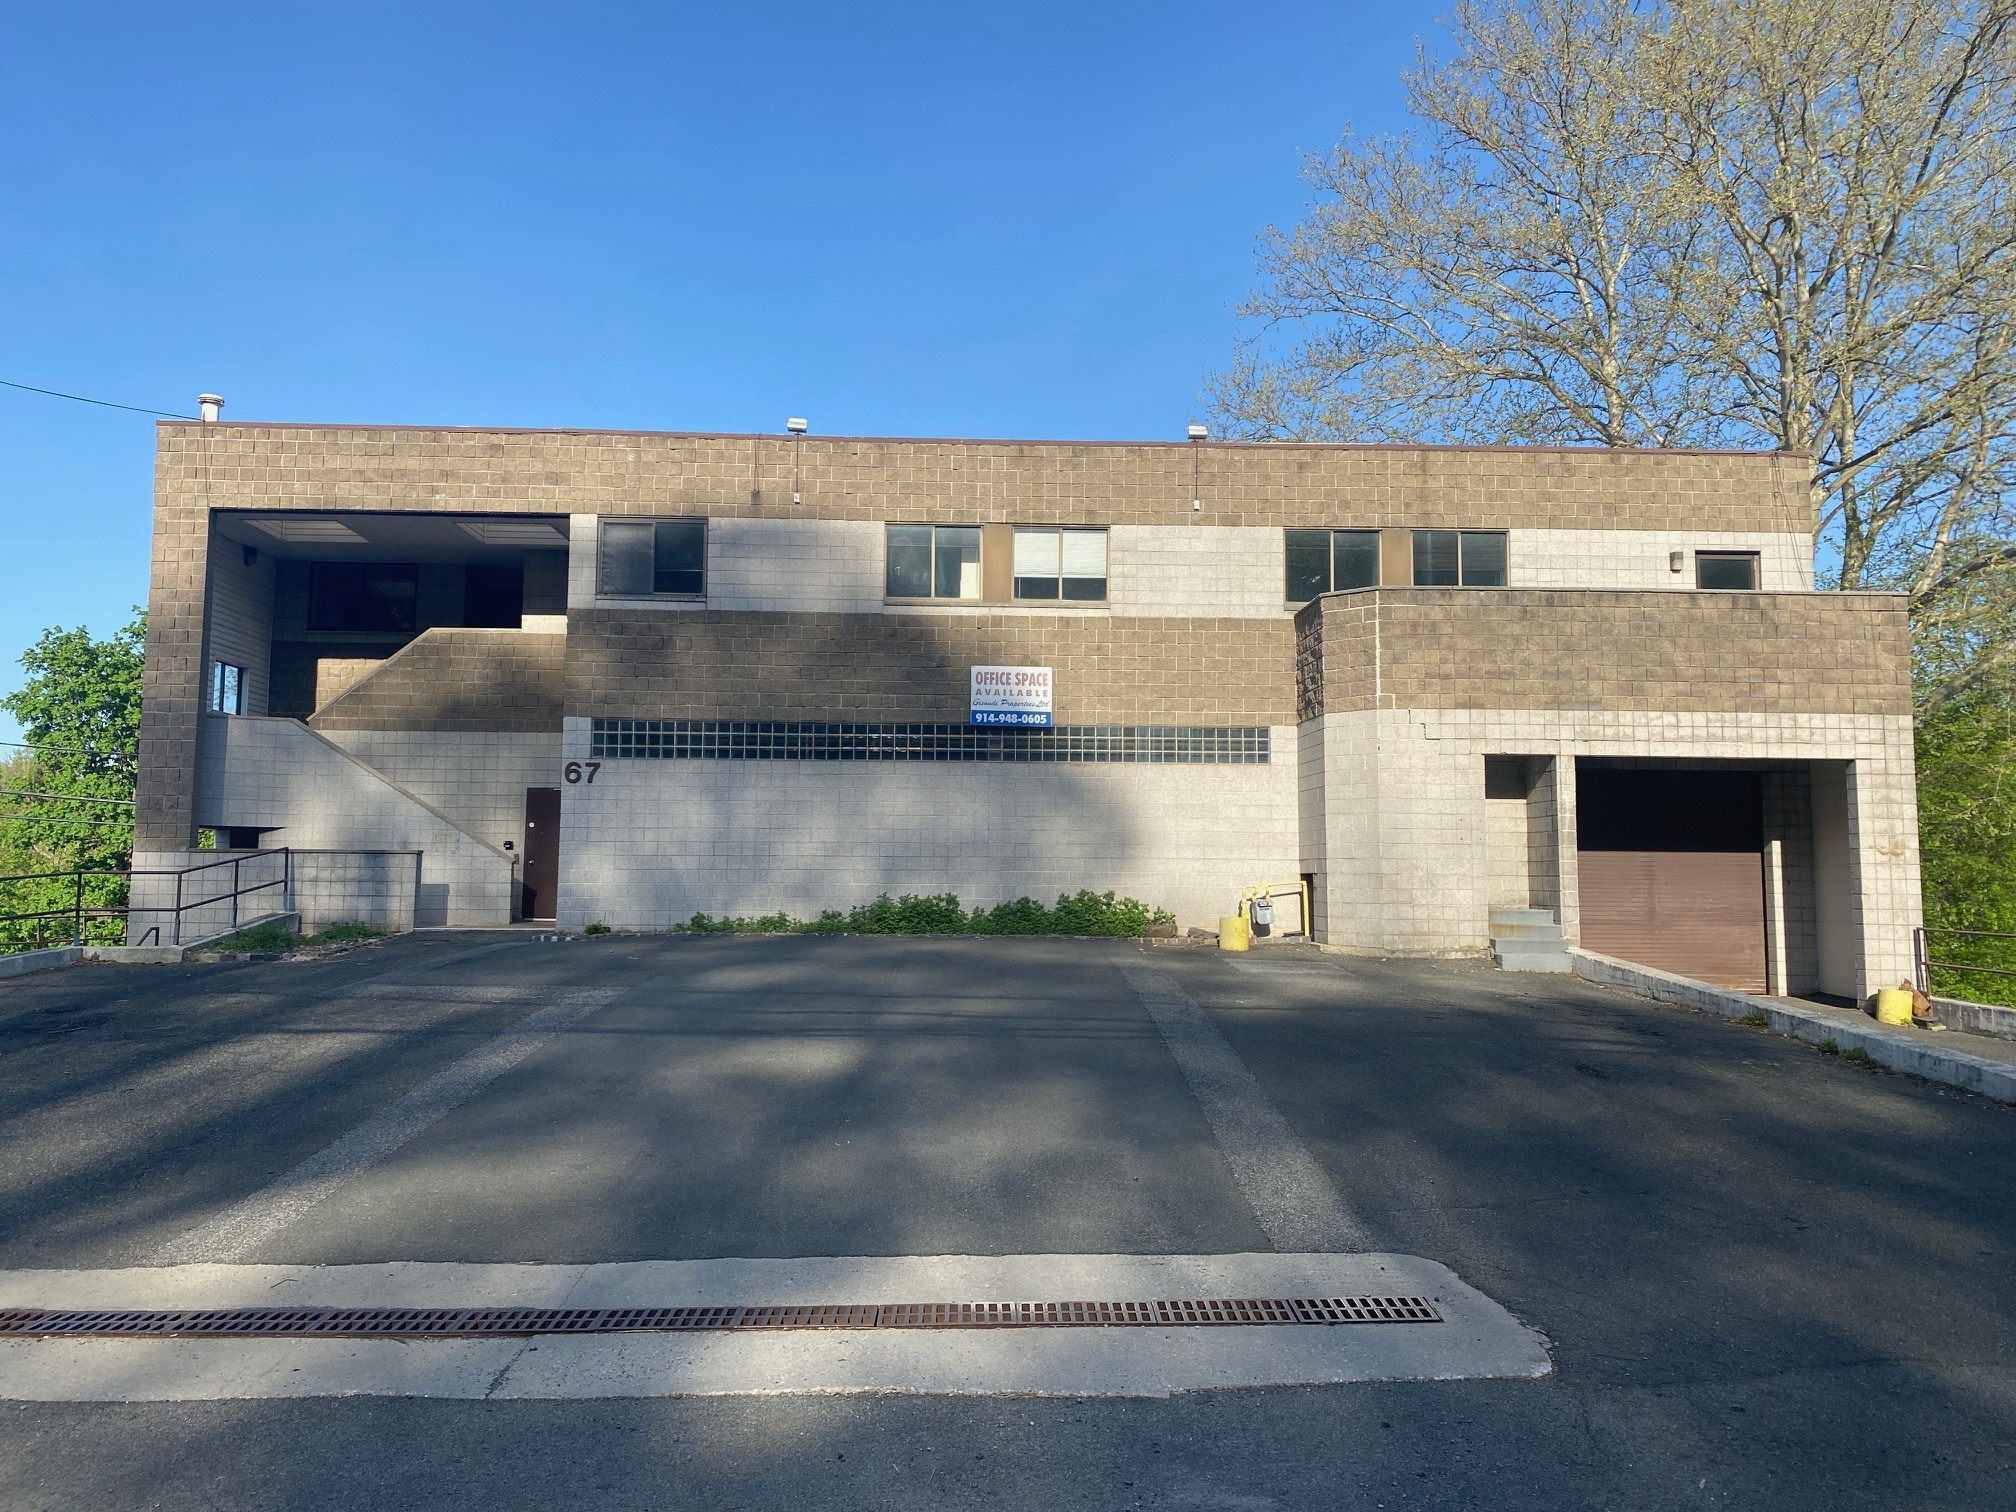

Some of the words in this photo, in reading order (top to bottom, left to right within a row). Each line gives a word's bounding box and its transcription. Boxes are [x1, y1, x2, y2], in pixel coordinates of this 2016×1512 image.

[975, 671, 1012, 686] OFFICE
[1014, 672, 1048, 686] SPACE
[975, 688, 1049, 697] AVAILABLE
[1000, 698, 1035, 708] Properties
[975, 713, 1047, 724] 914-948-0605
[564, 761, 601, 784] 67
